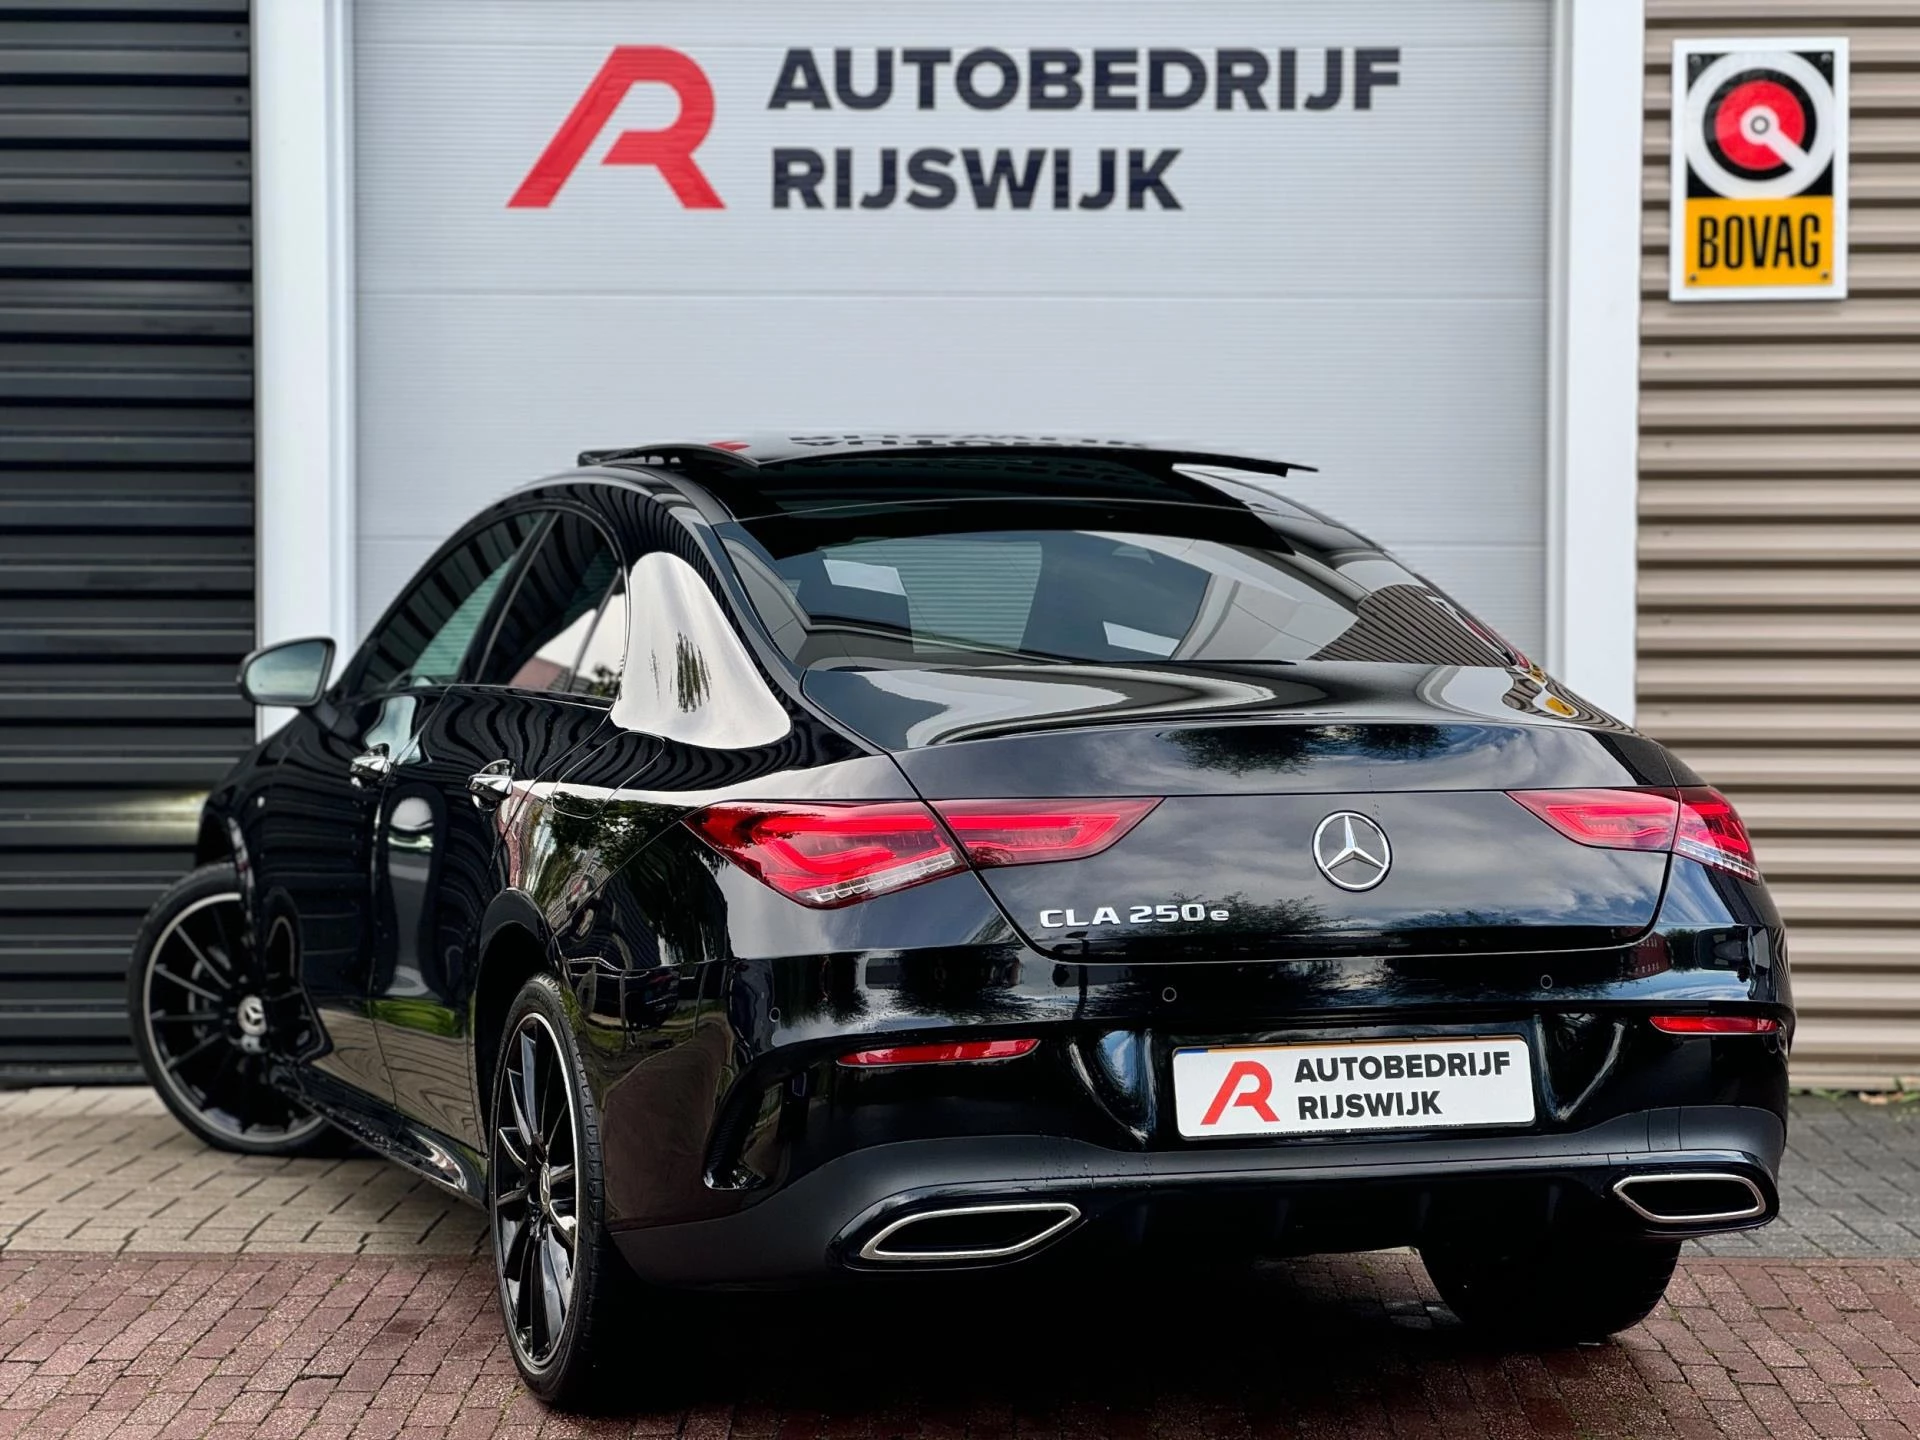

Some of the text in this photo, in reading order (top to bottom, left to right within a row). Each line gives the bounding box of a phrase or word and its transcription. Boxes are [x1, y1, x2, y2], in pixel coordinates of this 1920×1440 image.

[767, 47, 1401, 111] AUTOBEDRIJF
[771, 147, 1184, 211] RIJSWIJK
[1698, 213, 1821, 270] BOVAG
[1039, 906, 1121, 928] CLA
[1294, 1051, 1511, 1083] AUTOBEDRIJF
[1297, 1090, 1443, 1120] RIJSWIJK
